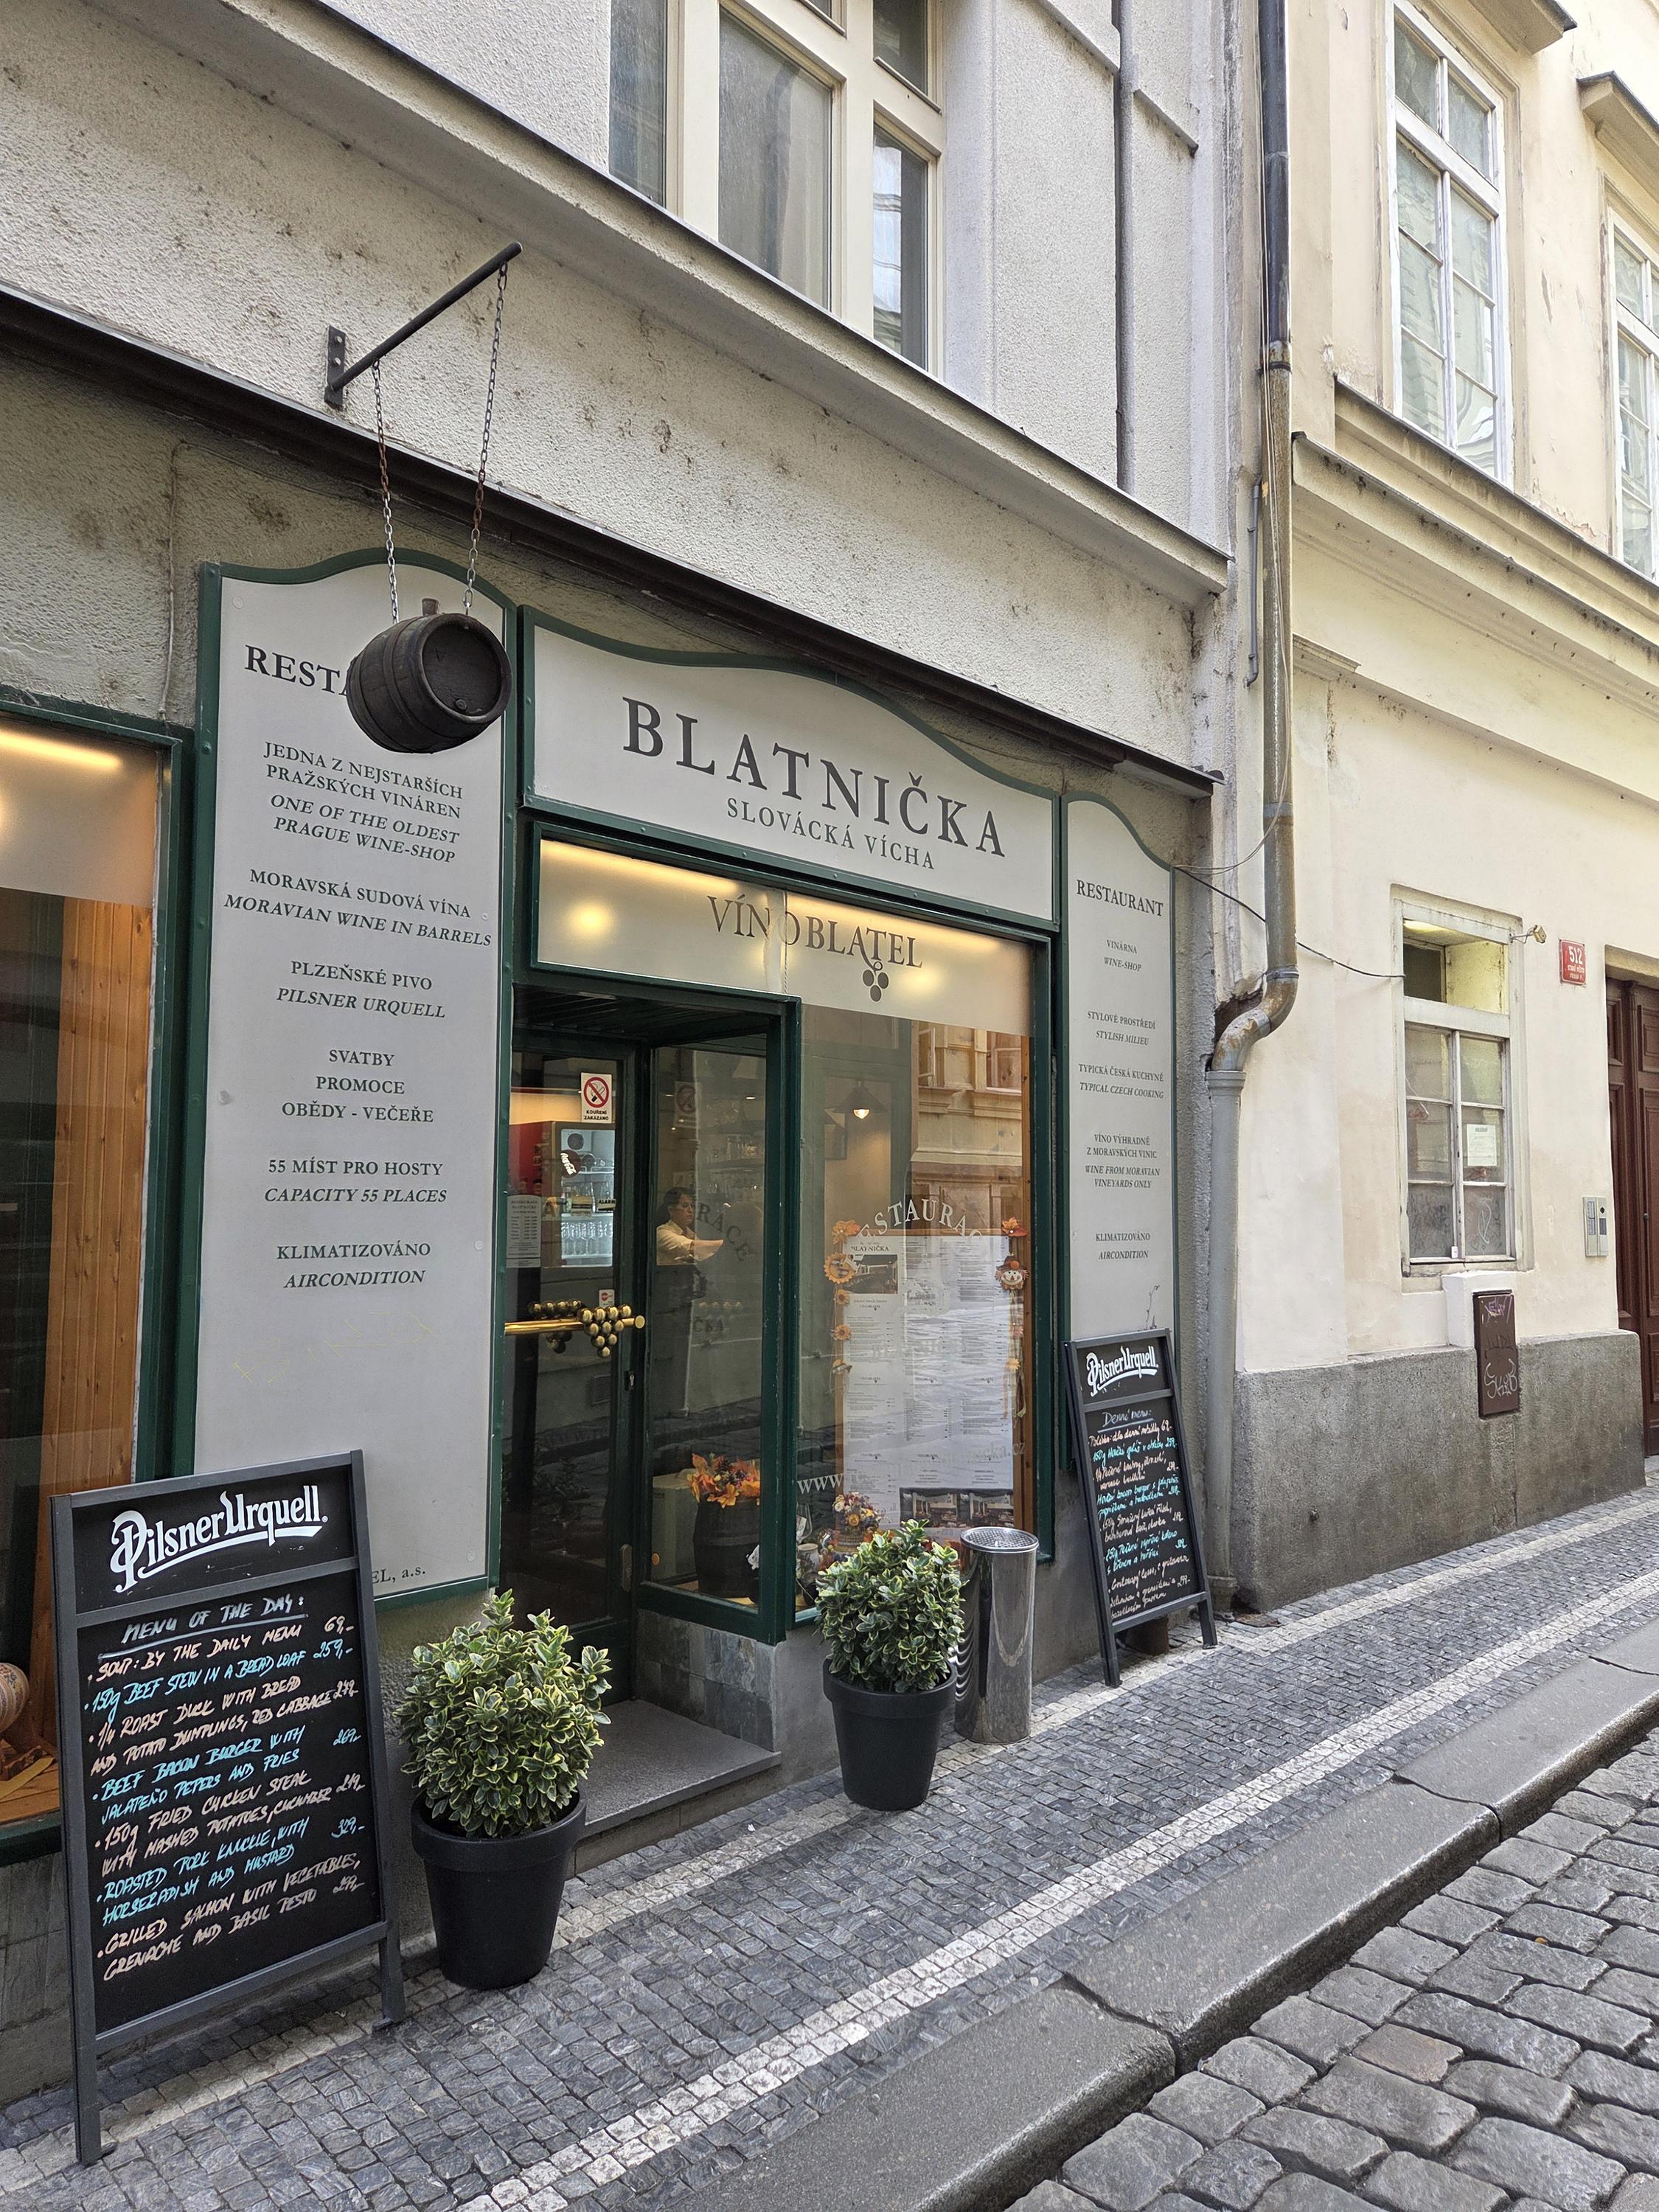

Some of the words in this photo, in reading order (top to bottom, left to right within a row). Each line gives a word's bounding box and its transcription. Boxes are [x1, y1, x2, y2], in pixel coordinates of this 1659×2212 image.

[264, 742, 326, 768] JEDNA
[332, 759, 343, 771] Z
[349, 762, 462, 799] NEJSTARŠÍCH
[622, 697, 1006, 858] BLATNIČKA
[267, 764, 375, 800] PRAŽSKÝCH
[383, 791, 460, 819] VINÁREN
[271, 794, 313, 814] ONE
[319, 804, 344, 821] OF
[349, 811, 387, 830] THE
[393, 820, 460, 844] OLDEST
[726, 797, 855, 849] SLOVÁCKÁ
[864, 834, 934, 870] VÍCHA
[274, 818, 350, 844] PRAGUE
[357, 833, 455, 863] WINE-SHOP
[250, 869, 352, 898] MORAVSKÁ
[357, 888, 424, 911] SUDOVÁ
[429, 900, 470, 918] VÍNA
[1077, 879, 1164, 917] RESTAURANT
[224, 894, 333, 922] MORAVIAN
[337, 912, 386, 931] WINE
[391, 921, 413, 935] IN
[417, 924, 491, 946] BARRELS
[706, 894, 924, 970] VÍNOBLATEL
[1107, 939, 1137, 954] VINÁRNA
[1568, 945, 1584, 965] 512
[291, 961, 386, 985] PLZEŇSKÉ
[392, 974, 432, 990] PIVO
[1104, 957, 1141, 972] WINE-SHOP
[276, 988, 357, 1009] PILSNER
[363, 998, 445, 1018] URQUELL
[1088, 1011, 1118, 1023] STYLOVÉ
[1120, 1016, 1155, 1029] PROSTŘEDÍ
[1096, 1030, 1124, 1042] STYLISH
[1125, 1034, 1149, 1046] MILIEU
[329, 1049, 394, 1067] SVATBY
[1079, 1063, 1108, 1075] TYPICKÁ
[1110, 1065, 1130, 1078] ČESKÁ
[316, 1077, 405, 1094] PROMOCE
[1079, 1082, 1109, 1093] TYPICAL
[1110, 1085, 1133, 1096] CZECH
[1134, 1088, 1164, 1099] COOKING
[282, 1100, 347, 1119] OBĚDY
[363, 1105, 434, 1122] VEČEŘE
[1094, 1132, 1111, 1143] VÍNO
[268, 1160, 286, 1174] 55
[292, 1155, 338, 1175] MÍST
[343, 1161, 378, 1175] PRO
[384, 1162, 443, 1176] HOSTY
[1093, 1147, 1137, 1158] MORAVSKÝCH
[1138, 1150, 1157, 1159] VINIC
[1085, 1165, 1104, 1174] WINE
[1105, 1166, 1124, 1175] FROM
[1125, 1166, 1160, 1176] MORAVIAN
[1094, 1179, 1133, 1188] VINEYARDS
[1134, 1180, 1152, 1189] ONLY
[264, 1188, 358, 1203] CAPACITY
[361, 1189, 378, 1203] 55
[383, 1189, 448, 1203] PLACES
[276, 1239, 431, 1259] KLIMATIZOVÁNO
[1096, 1231, 1150, 1241] KLIMATIZOVÁNO
[1099, 1251, 1148, 1260] AIRCONDITION
[283, 1270, 426, 1289] AIRCONDITION
[109, 1509, 227, 1593] Pilsner
[220, 1485, 321, 1546] Urquell
[402, 1567, 425, 1578] a.s.
[189, 1610, 211, 1628] OF
[220, 1602, 253, 1624] THE
[141, 1650, 166, 1670] BY
[173, 1641, 202, 1661] THE
[206, 1634, 251, 1658] DAILY
[262, 1624, 302, 1645] MENU
[123, 1677, 164, 1705] BEEF
[165, 1669, 202, 1695] STEW
[204, 1666, 220, 1684] IN
[223, 1666, 233, 1680] A
[234, 1655, 274, 1680] BREAD
[276, 1649, 307, 1673] LOAF
[120, 1710, 168, 1738] ROAST
[173, 1700, 215, 1725] DUCK
[221, 1686, 254, 1711] WITH
[261, 1674, 302, 1700] BREAD
[91, 1753, 116, 1776] AND
[123, 1738, 167, 1765] POTATO
[100, 1768, 147, 1801] BEEF
[151, 1755, 200, 1784] BACON
[206, 1737, 263, 1767] BURGER
[269, 1725, 306, 1750] WITH
[228, 1763, 254, 1783] AND
[263, 1748, 301, 1773] FRIES
[147, 1806, 192, 1834] FRIED
[201, 1784, 262, 1816] CHICKEN
[266, 1770, 312, 1796] STEAK
[102, 1849, 137, 1877] WITH
[145, 1827, 199, 1858] MASHED
[104, 1867, 167, 1900] ROASTED
[173, 1850, 209, 1875] PORK
[276, 1816, 310, 1840] WITH
[208, 1865, 235, 1889] AND
[244, 1843, 295, 1874] MUSTARD
[105, 1918, 167, 1955] GRILLED
[180, 1893, 235, 1930] SALMON
[241, 1878, 277, 1905] WITH
[192, 1924, 222, 1945] AND
[227, 1905, 271, 1934] BASIL
[277, 1888, 316, 1913] PESTO
